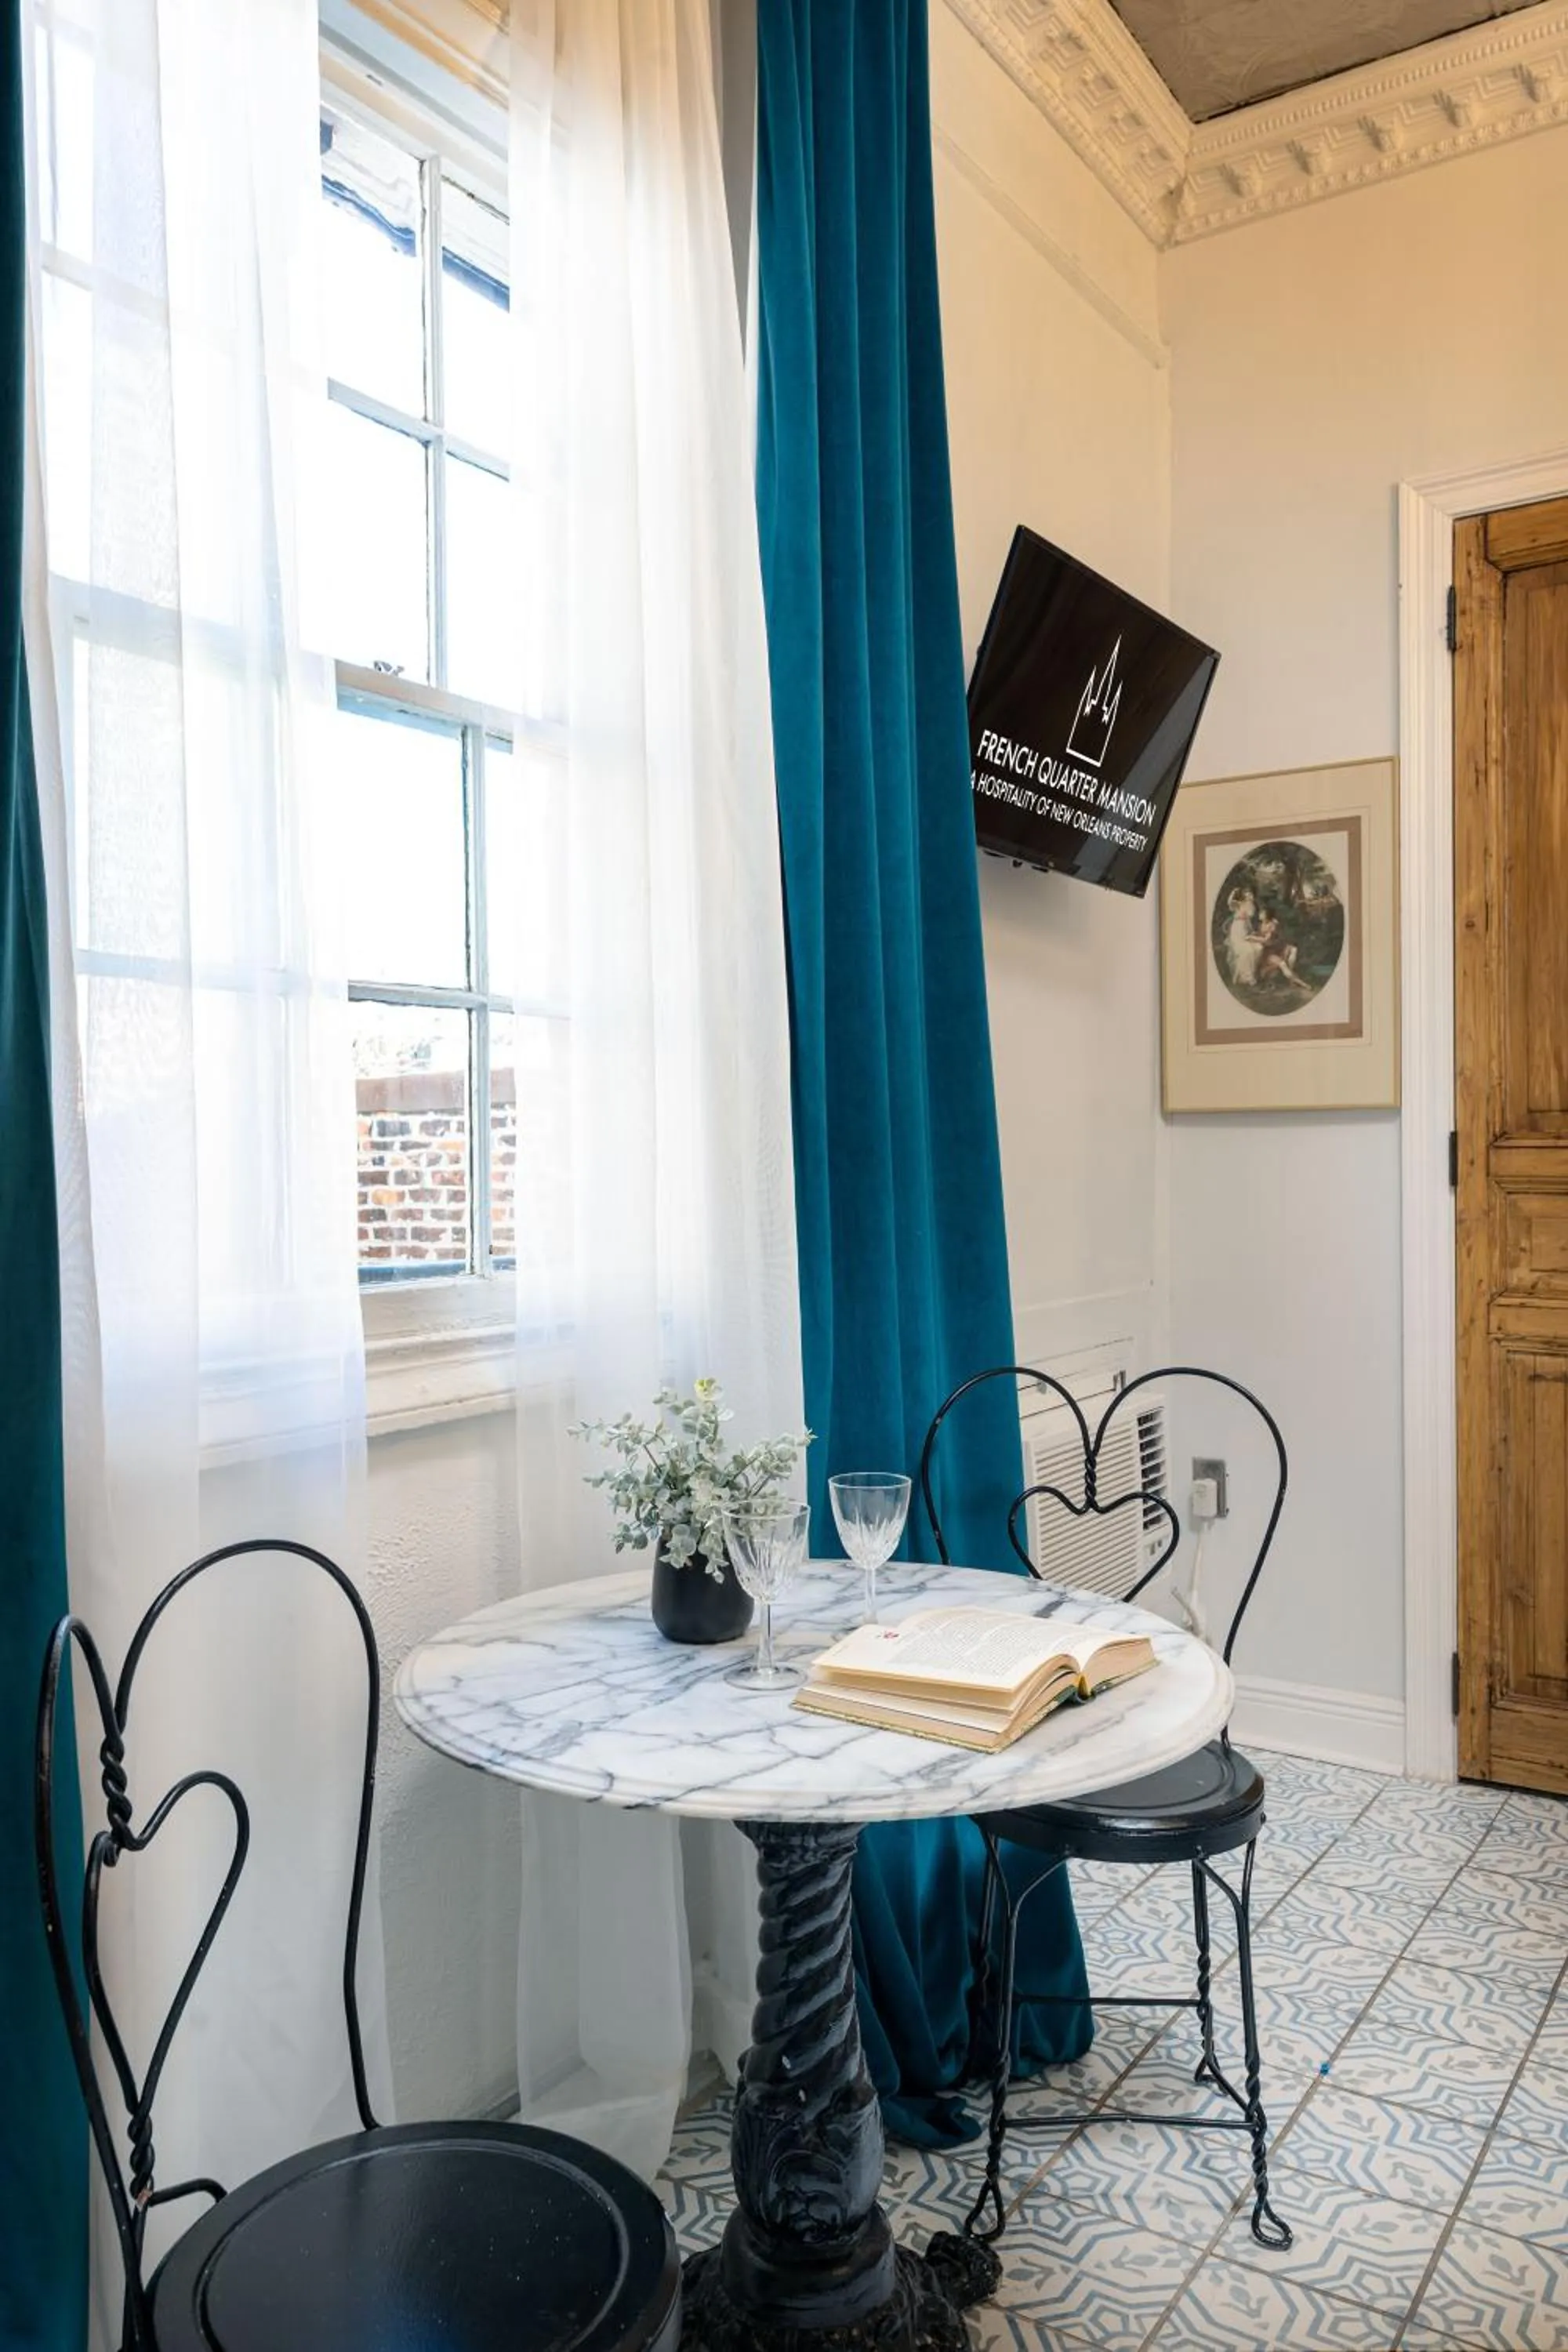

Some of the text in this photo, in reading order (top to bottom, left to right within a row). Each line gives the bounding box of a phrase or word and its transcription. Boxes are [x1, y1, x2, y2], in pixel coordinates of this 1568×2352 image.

[976, 772, 1038, 811] HOSPITALITY
[1036, 796, 1053, 816] OF
[1051, 804, 1074, 825] NEW
[1073, 811, 1112, 840] ORLEANS
[1109, 824, 1148, 852] PROPERTY
[977, 729, 1156, 826] FRENCH QUARTER MANSION
